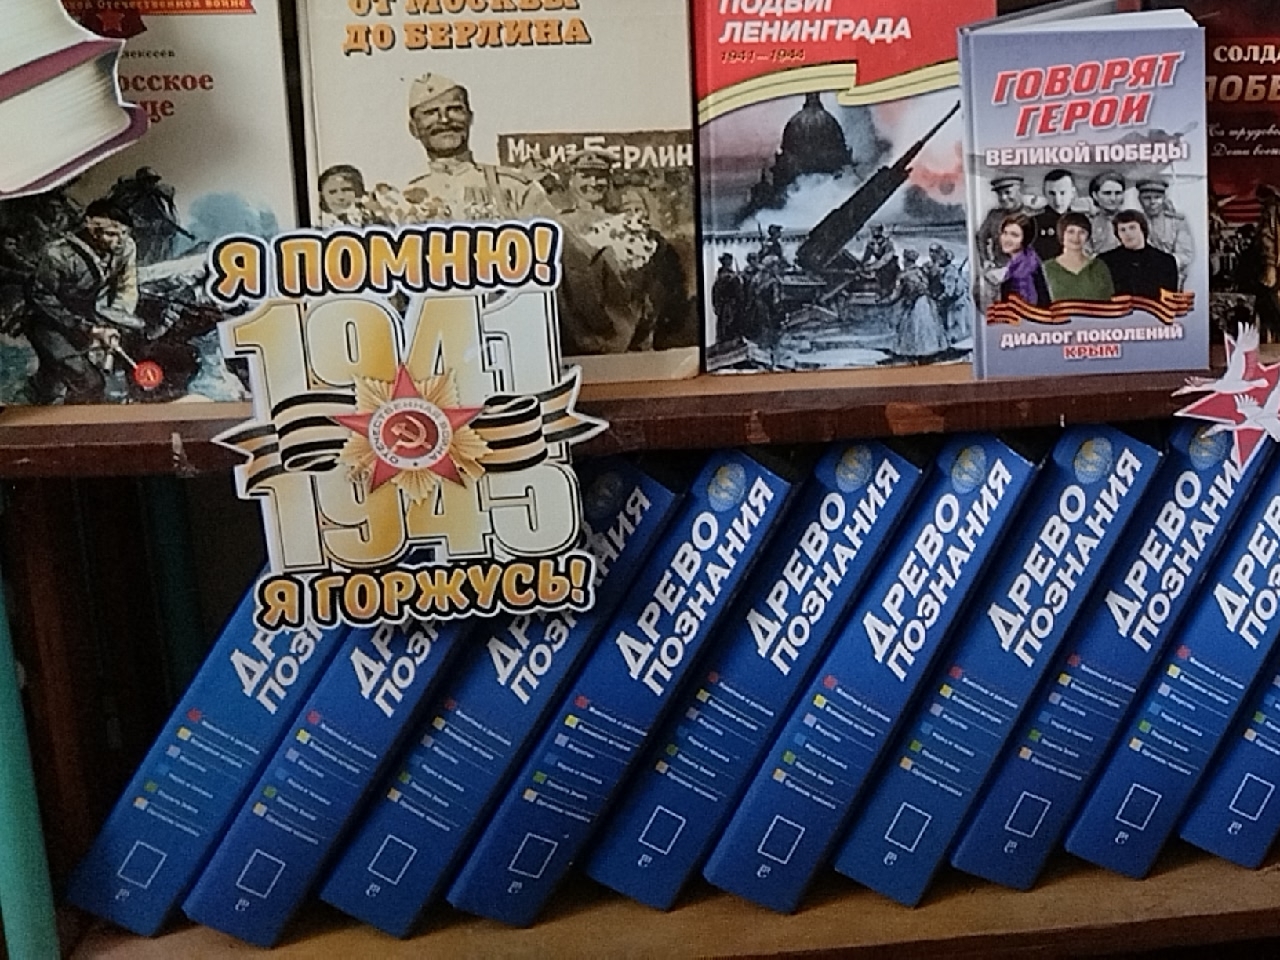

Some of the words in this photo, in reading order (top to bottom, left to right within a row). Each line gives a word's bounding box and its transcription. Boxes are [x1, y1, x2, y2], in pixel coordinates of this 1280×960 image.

[343, 23, 395, 56] ДО
[403, 17, 593, 52] БЕРЛИНА
[718, 17, 912, 44] ЛЕНИНГРАДА
[992, 51, 1184, 105] ГОВОРЯТ
[985, 141, 1090, 167] ВЕЛИКОЙ
[1094, 142, 1188, 165] ПОБЕДЫ
[1015, 93, 1152, 138] ГЕРОИ
[214, 236, 266, 298] Я
[278, 223, 559, 293] ПОМНЮ!
[232, 292, 563, 410] 1941
[1001, 328, 1074, 349] ДИАЛОГ
[1076, 322, 1184, 344] ПОКОЛЕНИЙ
[1063, 343, 1121, 360] КРЫМ
[260, 455, 582, 572] 1945
[770, 458, 901, 676] ПОЗНАНИЯ
[886, 457, 1013, 682] ПОЗНАНИЯ
[987, 484, 1086, 652] ДРЕВО
[1013, 447, 1143, 668] ПОЗНАНИЯ
[1104, 470, 1203, 637] ДРЕВО
[1131, 459, 1243, 652] ПОЗНАНИ
[257, 574, 301, 629] Я
[312, 555, 594, 622] ГОРЖУСЬ!
[615, 511, 718, 680] ДРЕВО
[642, 476, 775, 697] ПОЗНАНИЯ
[746, 492, 846, 658] ДРЕВО
[863, 493, 961, 663] ДРЕВО
